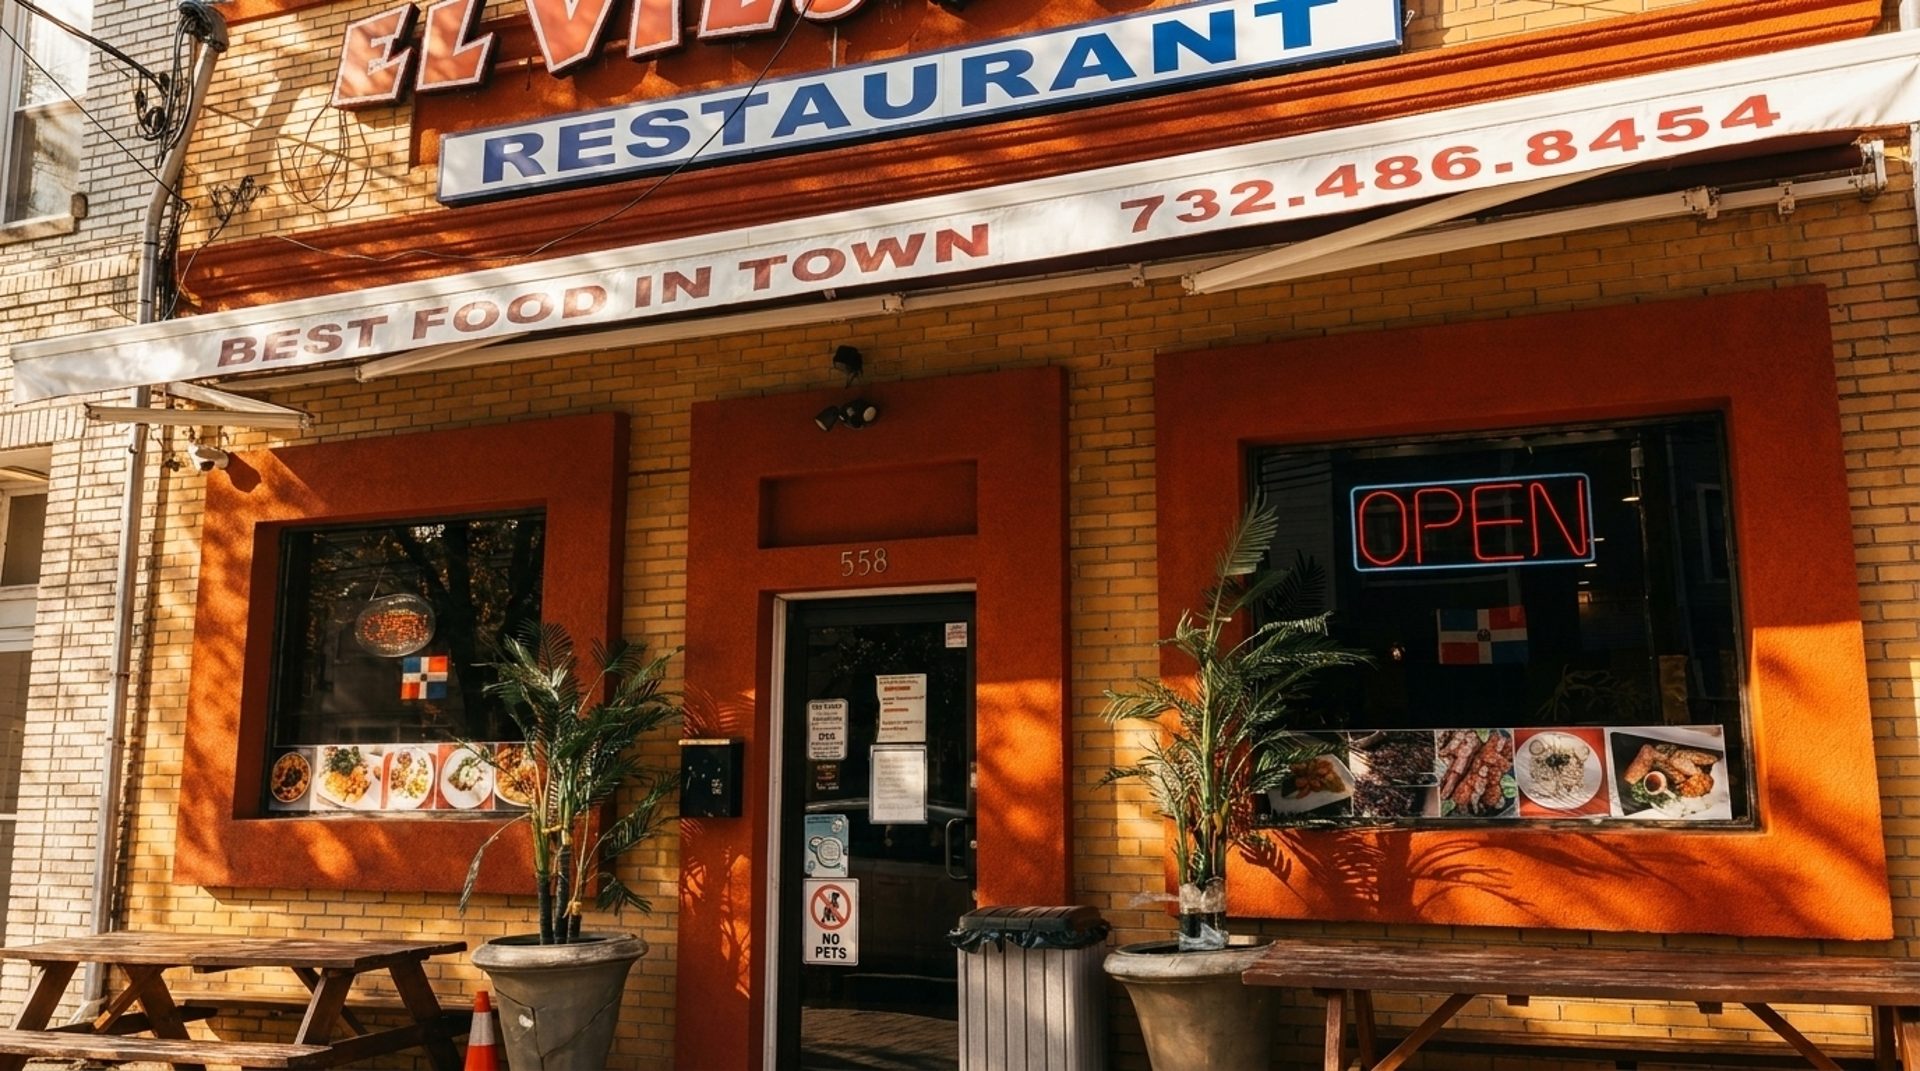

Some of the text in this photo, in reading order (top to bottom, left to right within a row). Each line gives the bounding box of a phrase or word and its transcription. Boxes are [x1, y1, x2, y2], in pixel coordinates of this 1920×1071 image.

[331, 0, 493, 106] EL
[482, 0, 1337, 184] RESTAURANT
[1120, 94, 1782, 234] 732.486.8454
[217, 223, 990, 368] BEST FOOD IN TOWN
[841, 547, 888, 577] 558
[1358, 479, 1588, 566] OPEN
[815, 946, 847, 959] PETS
[822, 933, 840, 945] NO
